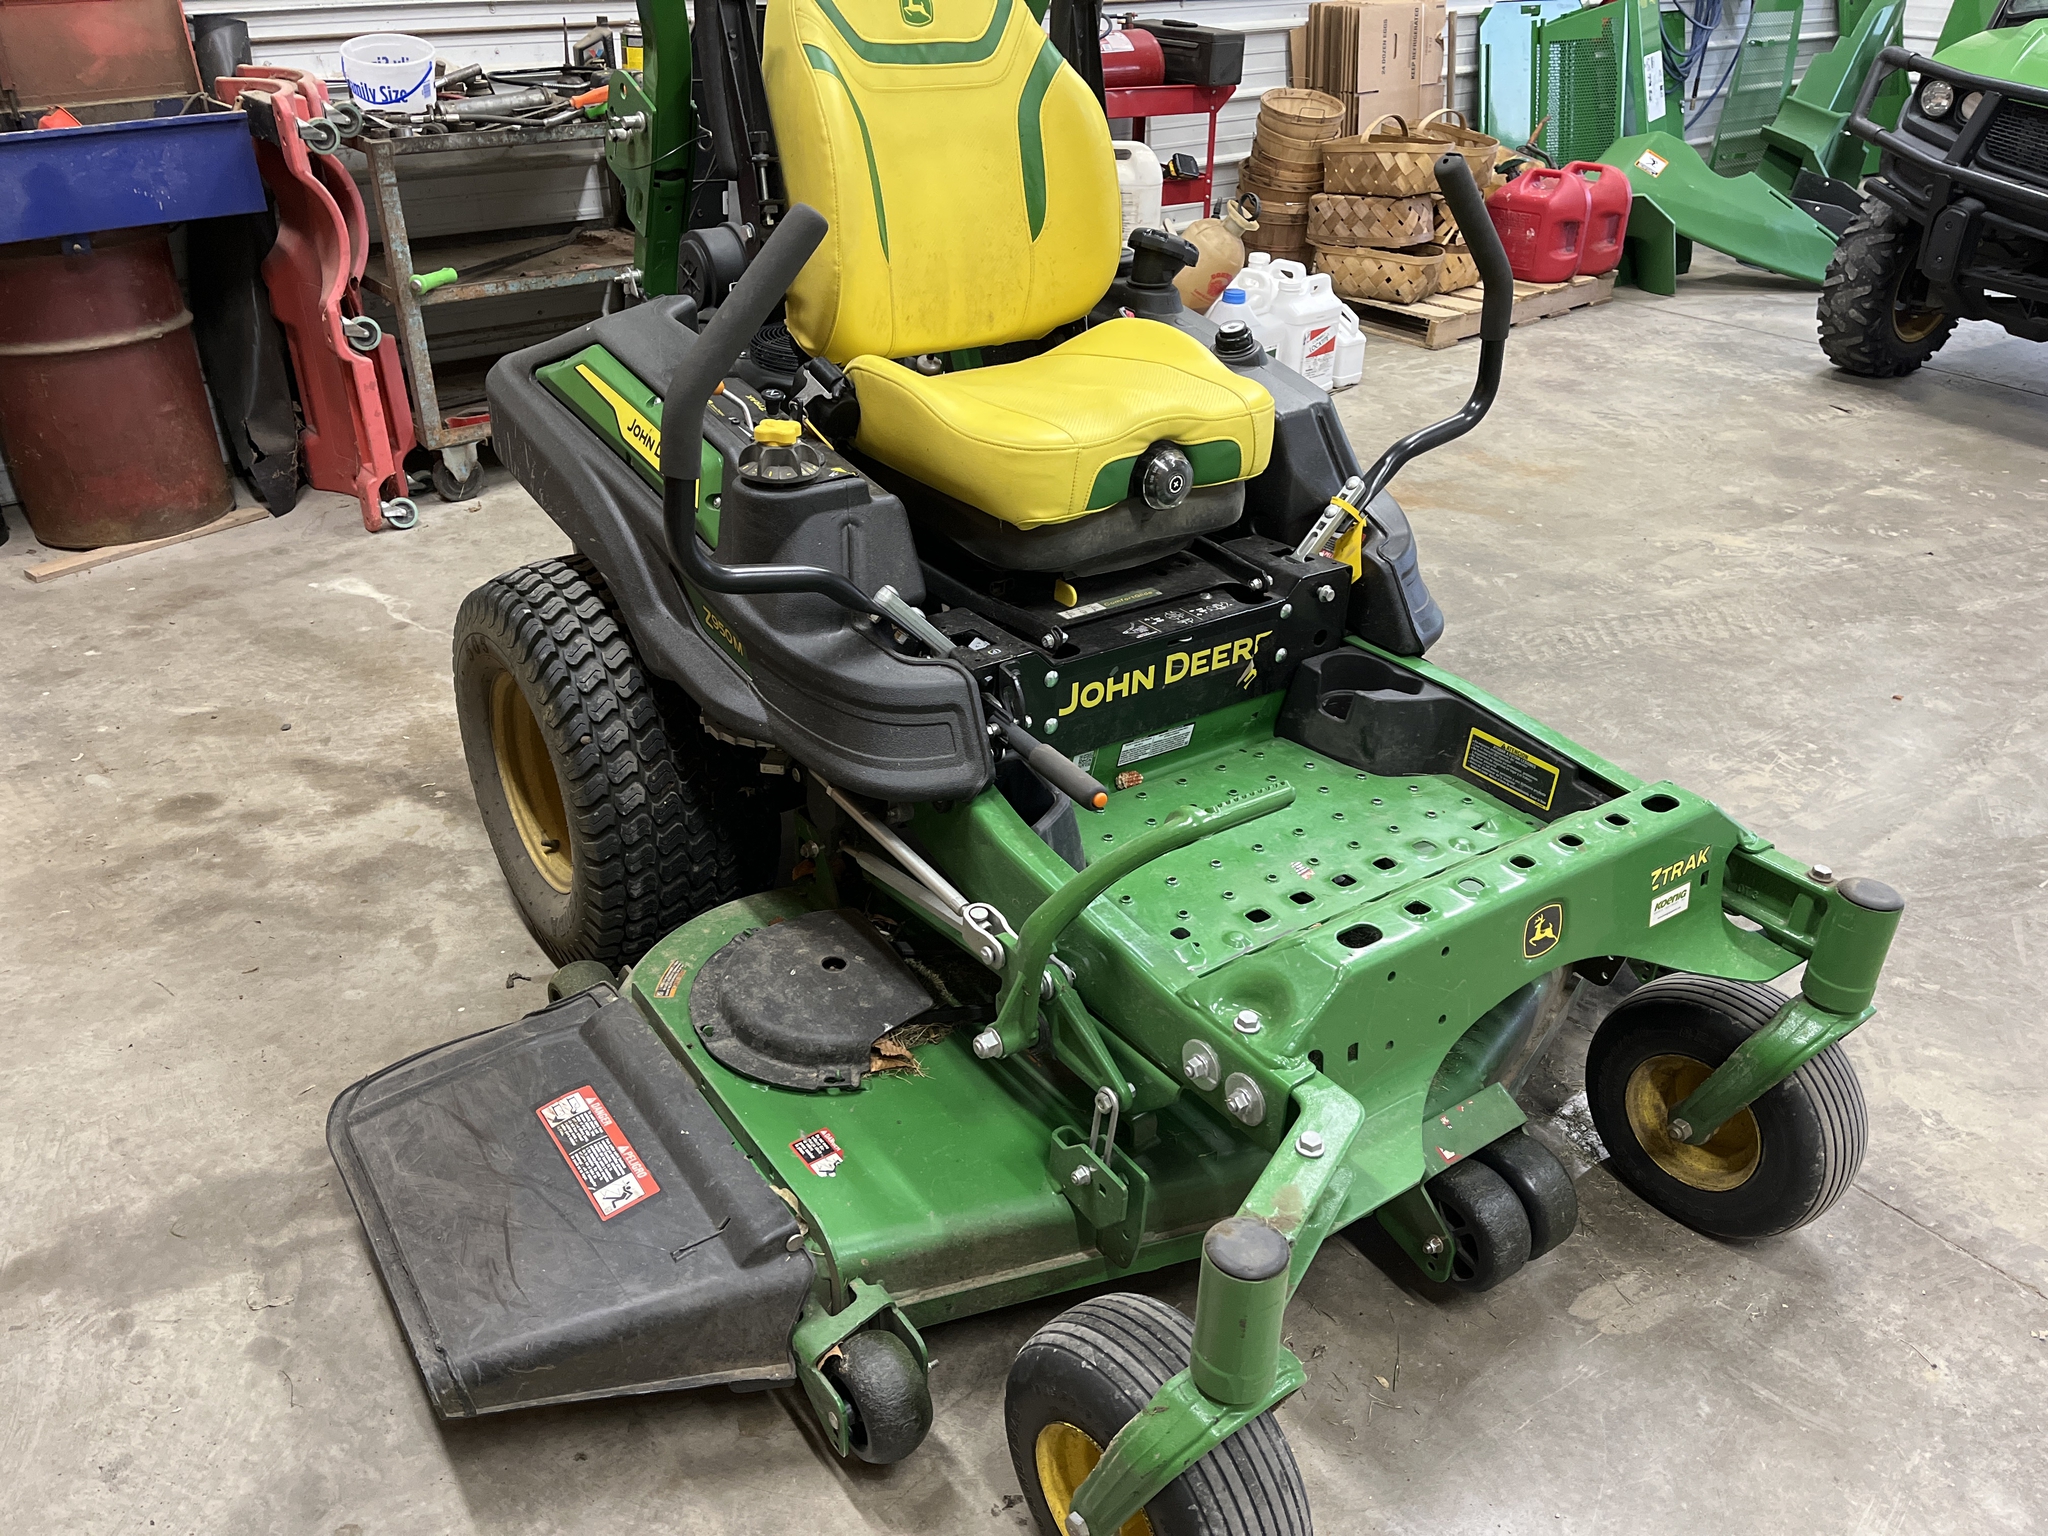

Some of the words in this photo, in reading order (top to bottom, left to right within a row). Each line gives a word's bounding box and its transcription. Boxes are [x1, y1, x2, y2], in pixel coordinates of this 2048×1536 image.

[379, 85, 408, 103] Size
[627, 418, 656, 452] JOHN
[702, 605, 744, 657] Z950M
[1058, 664, 1155, 717] JOHN
[590, 1102, 613, 1127] DANGER
[623, 1151, 648, 1179] PELIGRO
